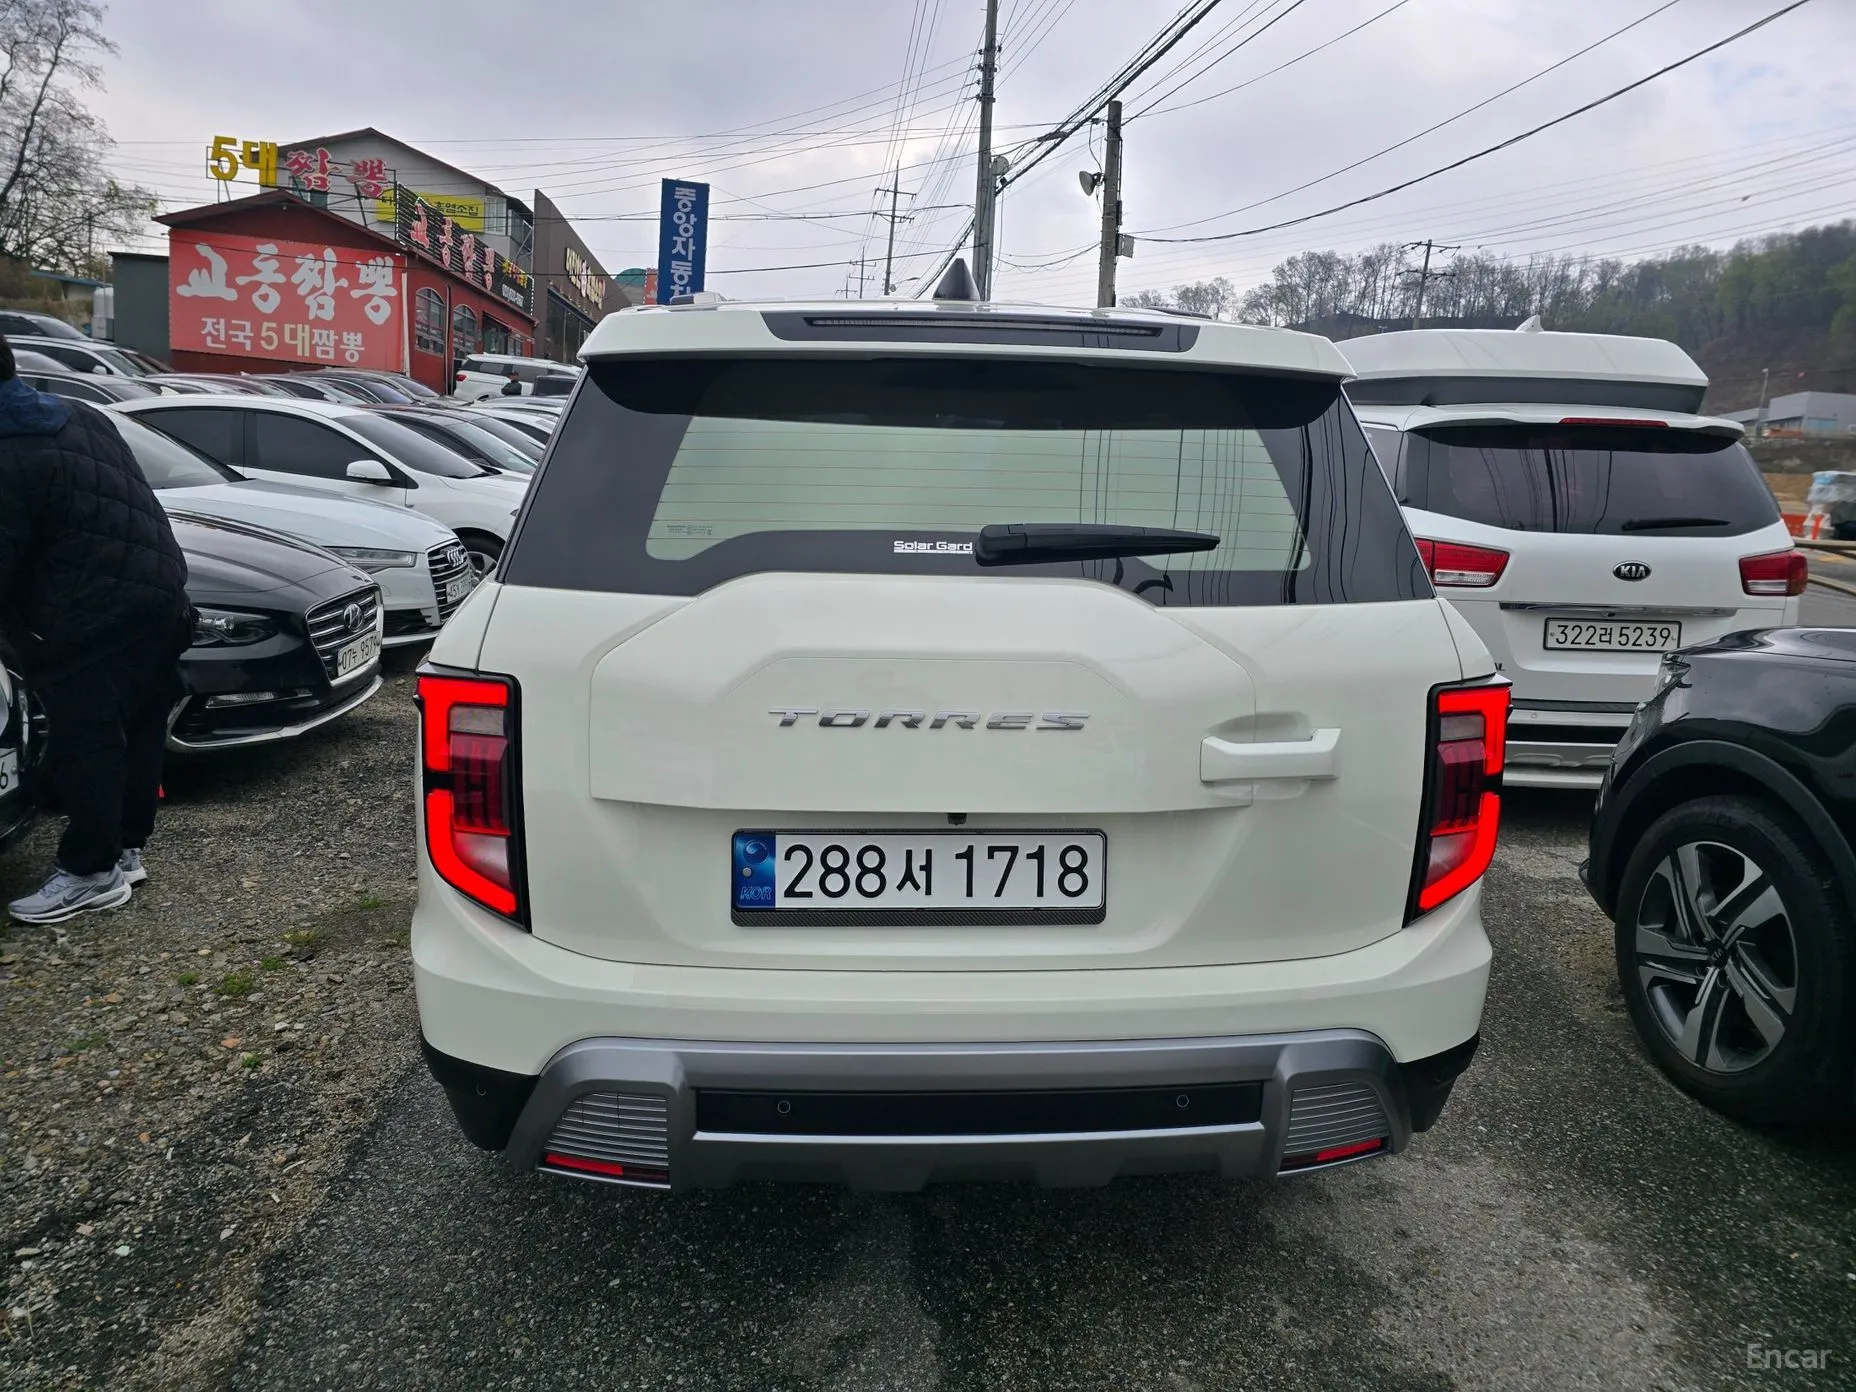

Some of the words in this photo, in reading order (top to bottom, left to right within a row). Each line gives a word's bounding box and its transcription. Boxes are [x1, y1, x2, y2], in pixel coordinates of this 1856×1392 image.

[176, 243, 398, 325] 교동짬뽕
[893, 541, 934, 550] Solar
[936, 541, 973, 551] Gard
[1620, 565, 1646, 578] KIA
[1555, 624, 1613, 645] 322러
[1618, 626, 1671, 647] 5239
[768, 708, 1091, 731] TORRES
[783, 843, 933, 898] 288서
[954, 844, 1089, 898] 1718
[740, 885, 772, 900] KOR
